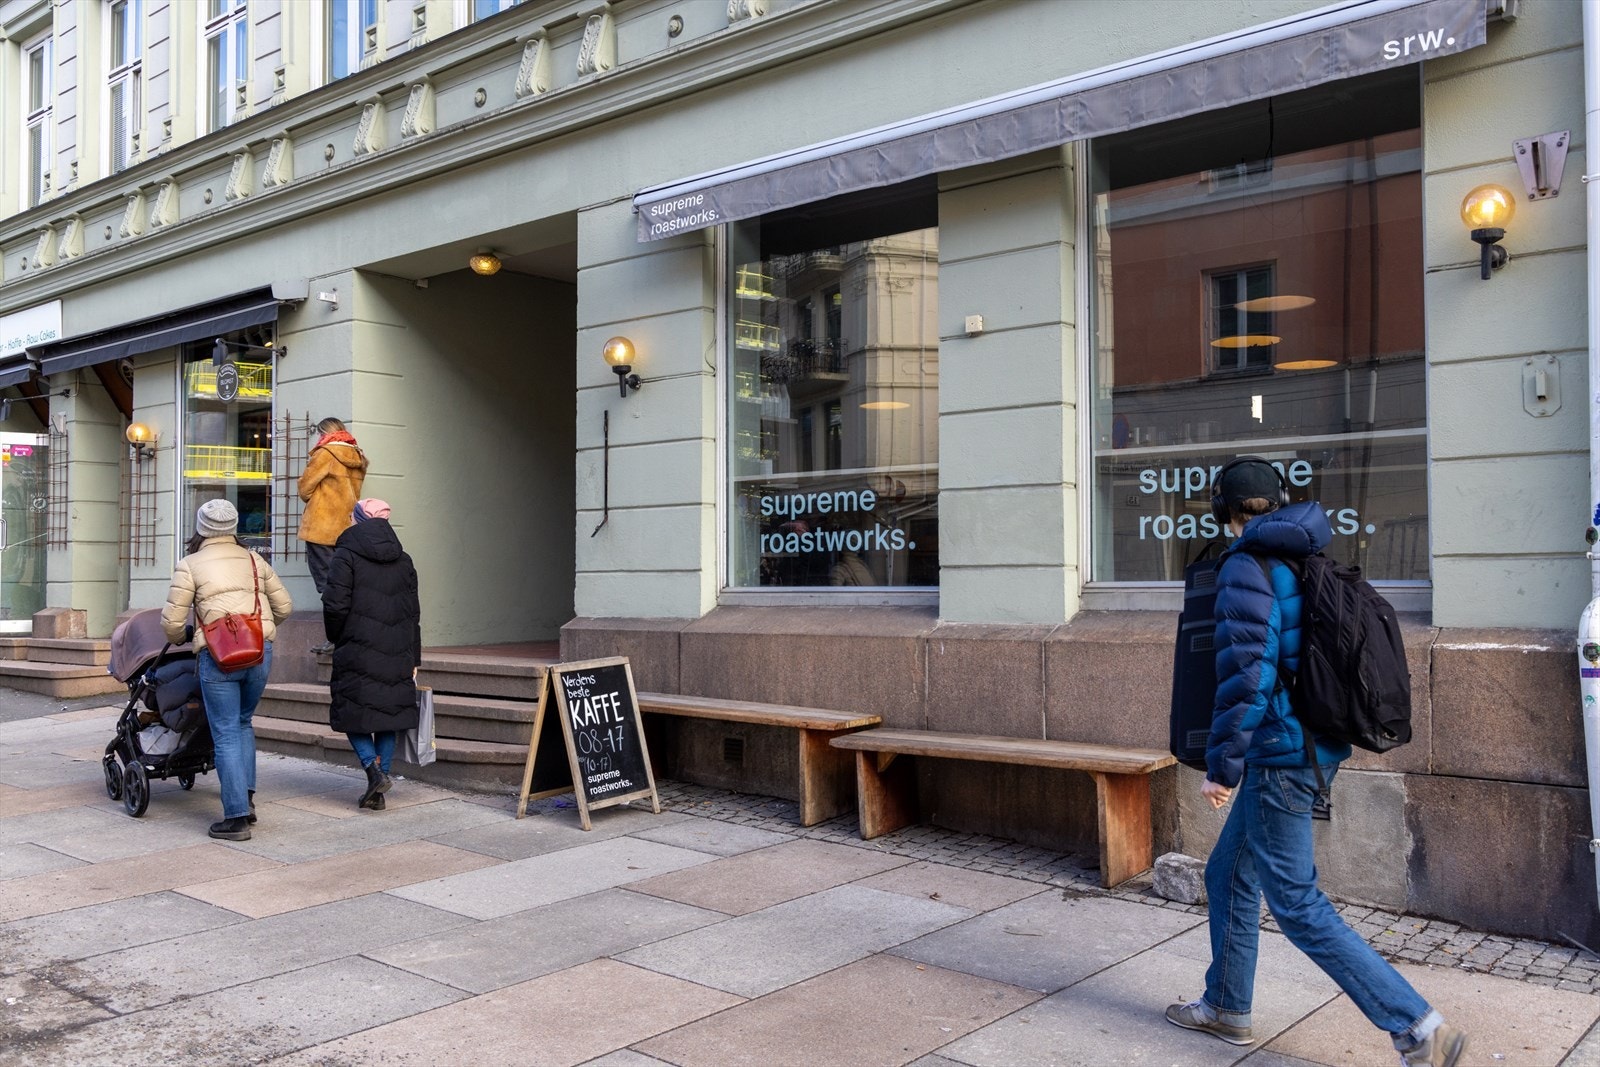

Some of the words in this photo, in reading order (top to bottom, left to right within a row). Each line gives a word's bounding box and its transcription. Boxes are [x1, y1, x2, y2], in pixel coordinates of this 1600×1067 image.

[1383, 28, 1455, 60] srw.
[651, 194, 704, 216] supreme
[651, 209, 719, 235] roastworks.
[1139, 459, 1313, 499] supre
[760, 489, 876, 520] supreme
[760, 523, 916, 554] roastworks.
[562, 673, 596, 688] Verdens
[567, 687, 591, 698] beste
[569, 691, 624, 730] KAFFE
[587, 769, 621, 784] supreme
[590, 778, 633, 795] roastworks.
